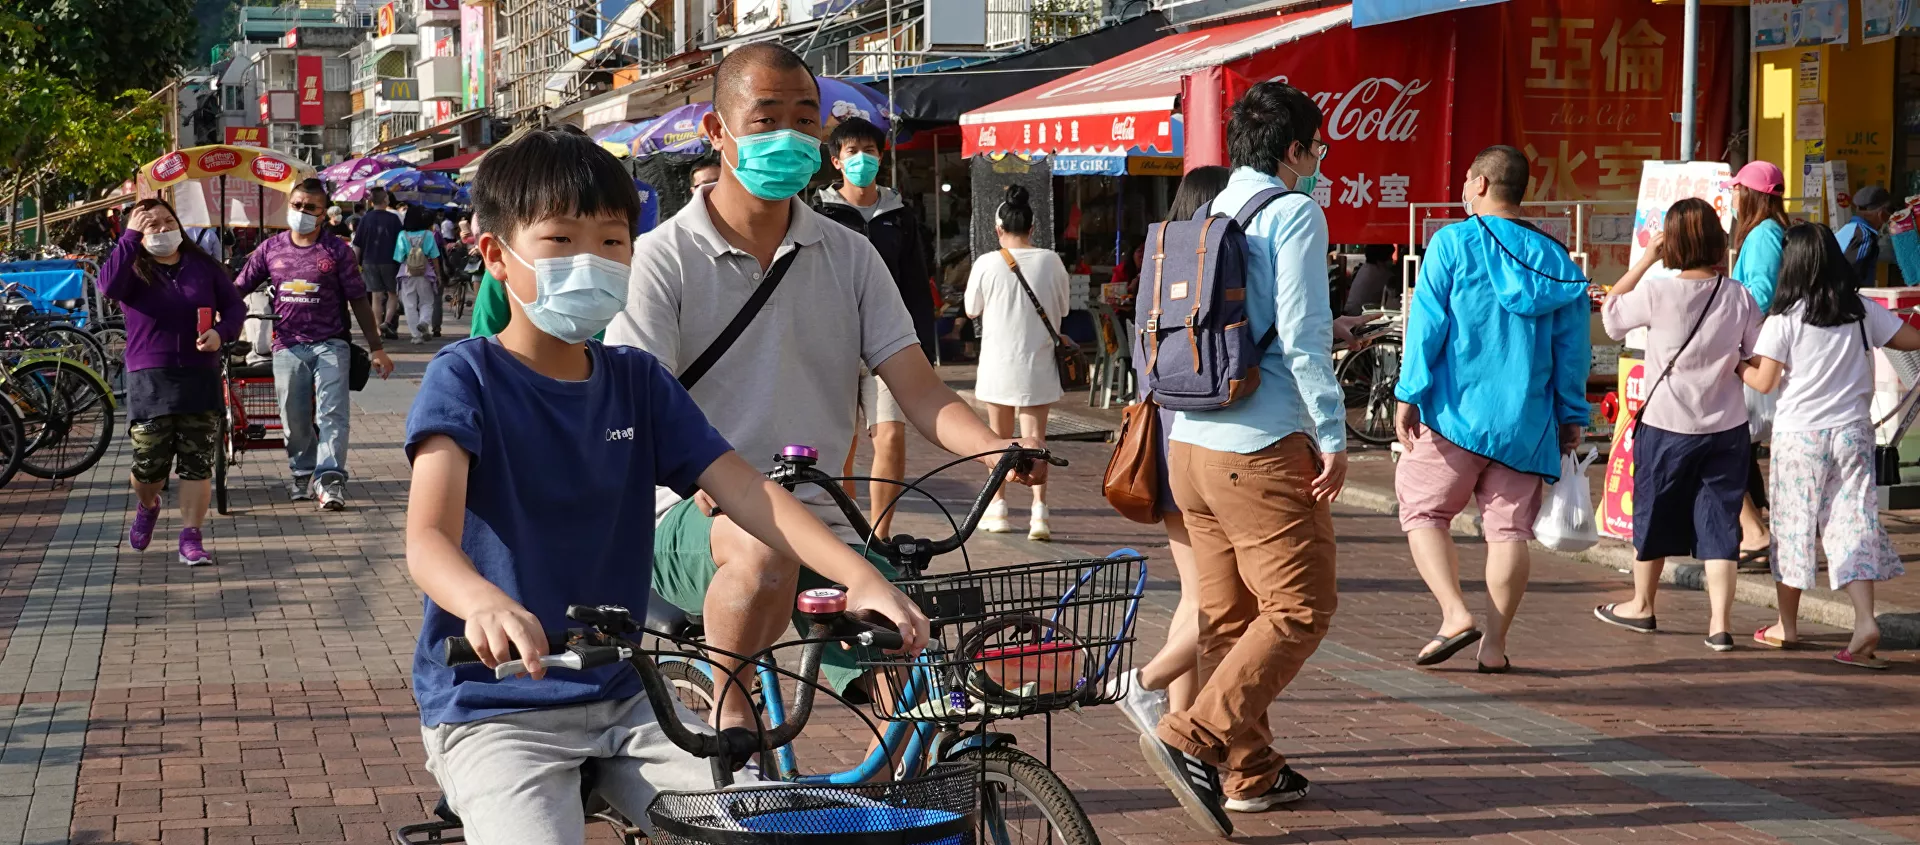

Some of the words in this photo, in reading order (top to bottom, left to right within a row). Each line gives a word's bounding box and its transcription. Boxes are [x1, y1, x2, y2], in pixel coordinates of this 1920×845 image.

[1525, 17, 1666, 92] 亞倫
[1053, 160, 1077, 171] LUE
[1080, 160, 1111, 171] GIRL
